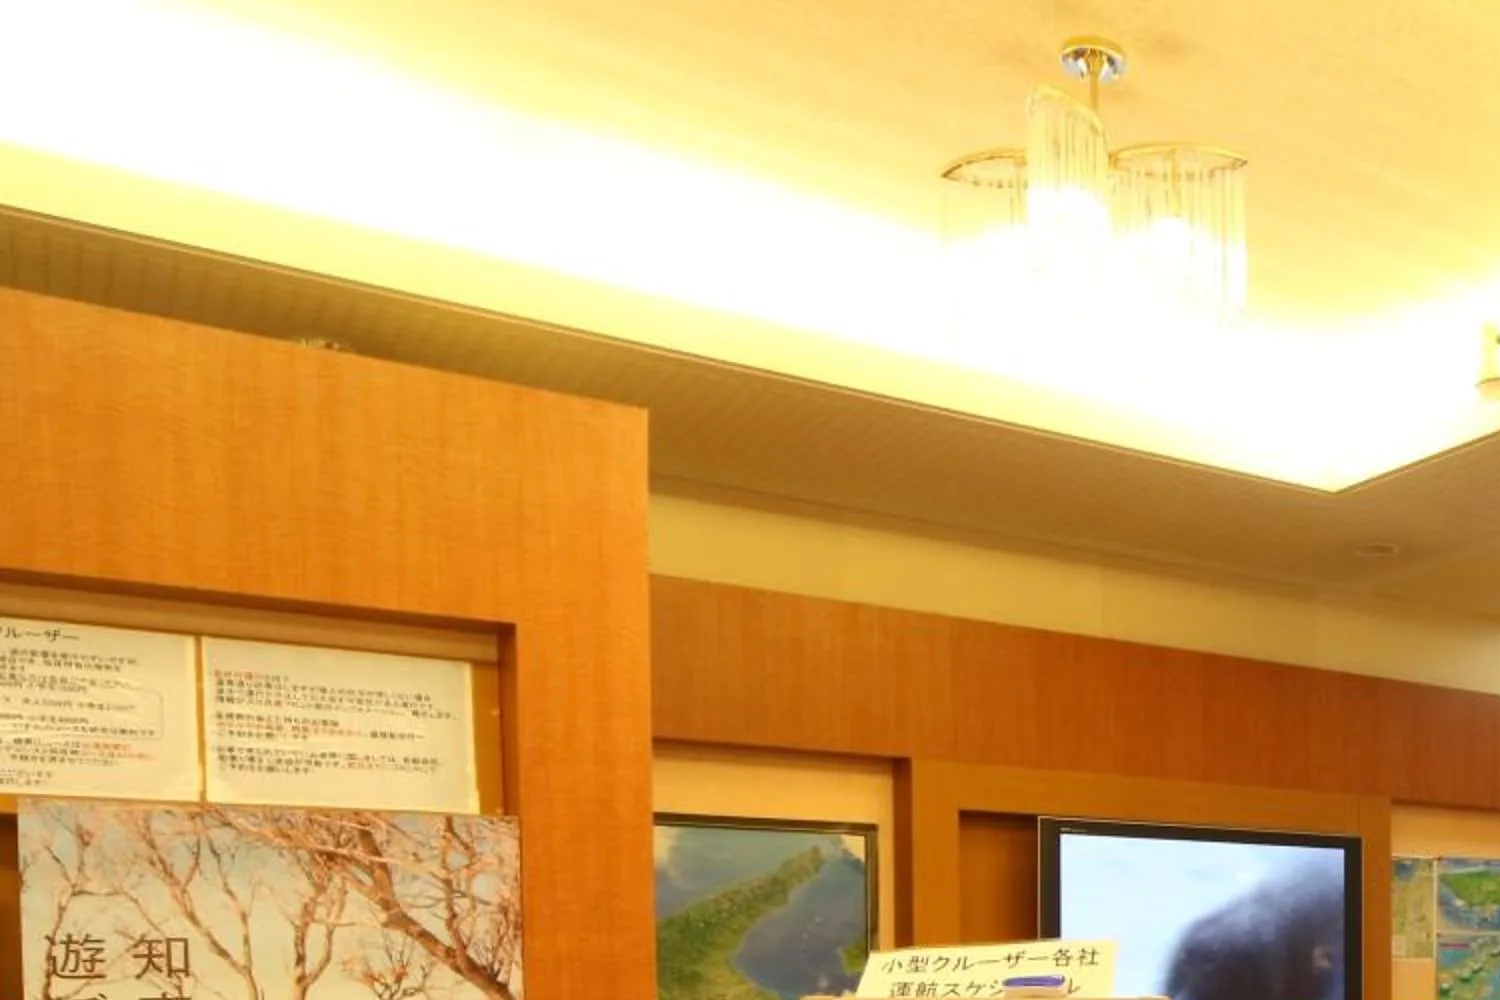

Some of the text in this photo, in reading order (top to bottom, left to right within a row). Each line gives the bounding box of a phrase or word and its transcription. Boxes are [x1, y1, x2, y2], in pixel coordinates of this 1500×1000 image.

[0, 627, 80, 642] ルーザー
[881, 947, 1101, 974] 小型クルーザー各社
[890, 978, 1082, 999] 運航スケジル
